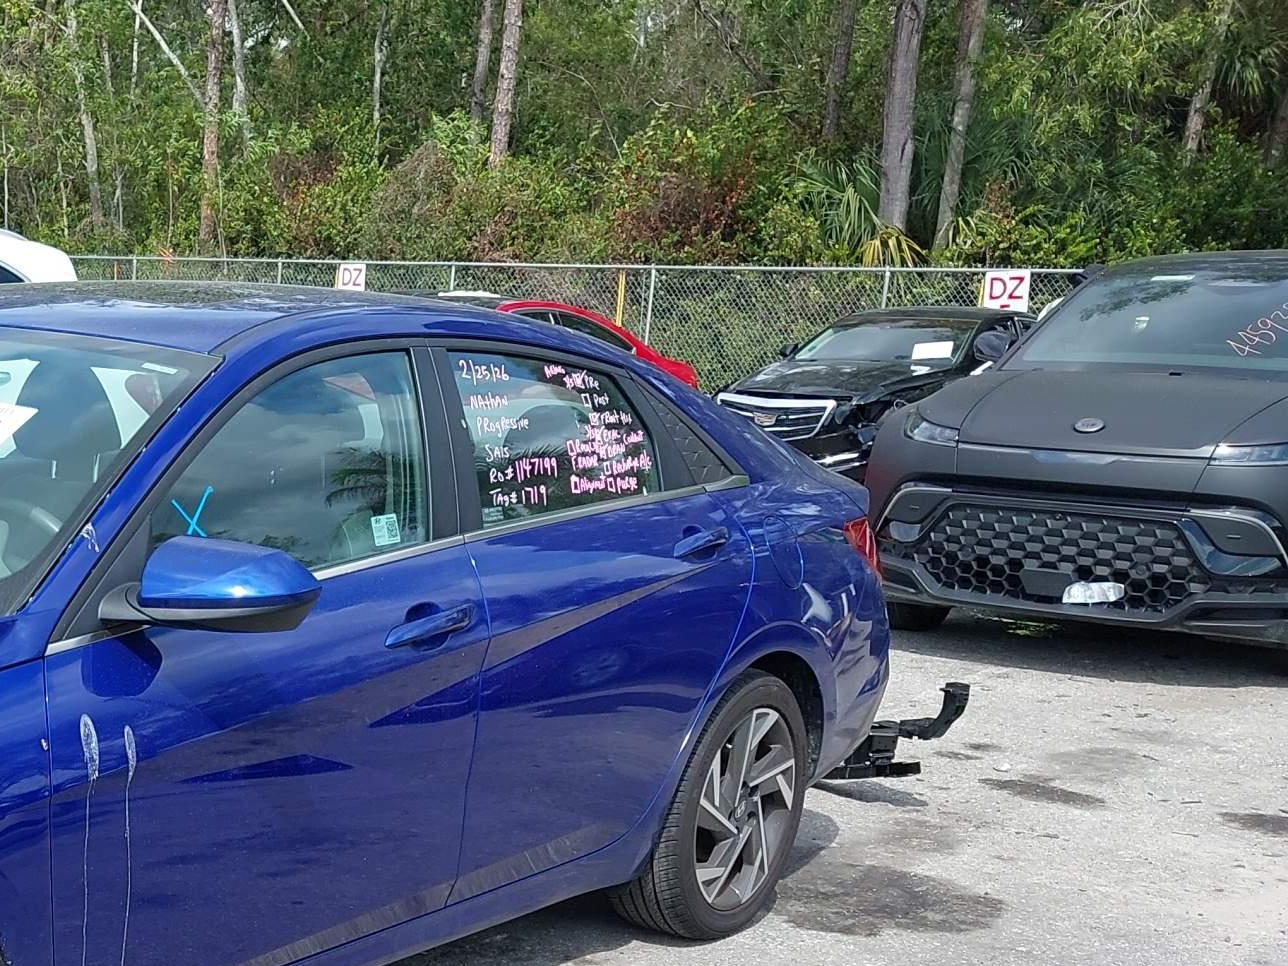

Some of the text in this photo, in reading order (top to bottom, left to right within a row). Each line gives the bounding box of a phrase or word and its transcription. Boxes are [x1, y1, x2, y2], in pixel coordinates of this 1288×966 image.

[342, 268, 363, 286] DZ
[989, 276, 1025, 300] DZ
[458, 359, 510, 386] 2/25/26
[515, 457, 558, 483] 1147199
[522, 484, 547, 507] 1719
